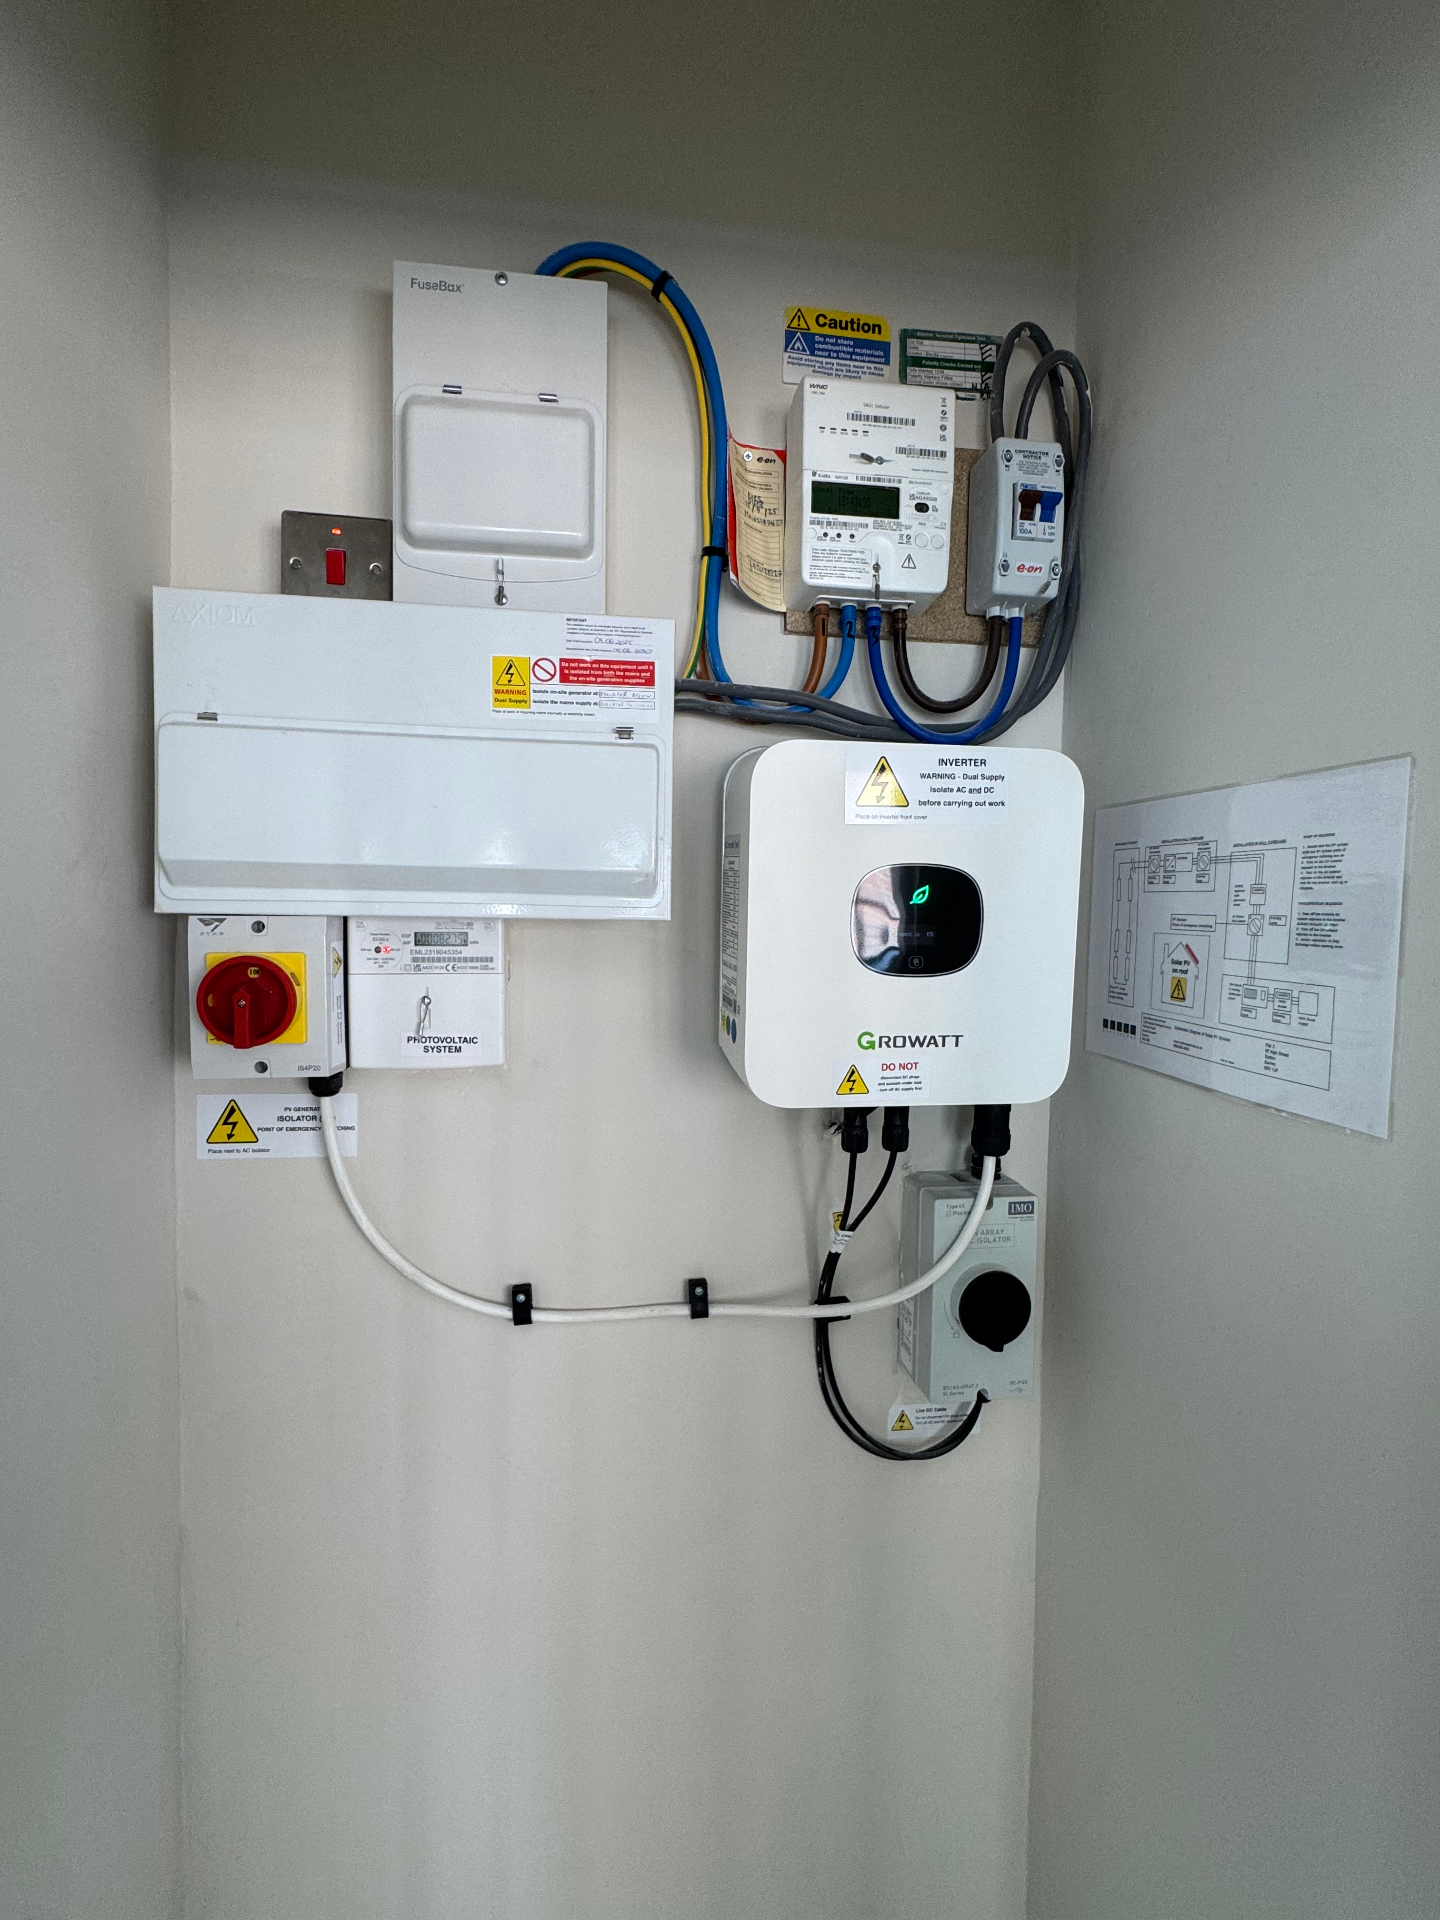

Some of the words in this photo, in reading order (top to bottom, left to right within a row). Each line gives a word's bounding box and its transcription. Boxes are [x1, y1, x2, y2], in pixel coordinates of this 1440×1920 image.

[410, 278, 462, 293] FuseBox
[815, 313, 882, 335] Caution
[815, 344, 853, 352] combustible
[855, 348, 884, 356] materials
[804, 357, 823, 365] storing
[852, 354, 885, 363] equipment
[787, 360, 816, 368] equipment
[845, 367, 860, 375] likely
[812, 369, 833, 377] damage
[171, 604, 254, 627] AXIOM
[938, 758, 986, 767] INVERTER
[963, 773, 978, 781] Dual
[981, 773, 1005, 782] Supply
[943, 800, 972, 808] carrying
[407, 1036, 478, 1044] PHOTOVOLTAIC
[857, 1031, 964, 1050] GROWATT
[881, 1063, 896, 1071] DO
[899, 1062, 919, 1071] NOT
[1011, 1203, 1032, 1213] IMO
